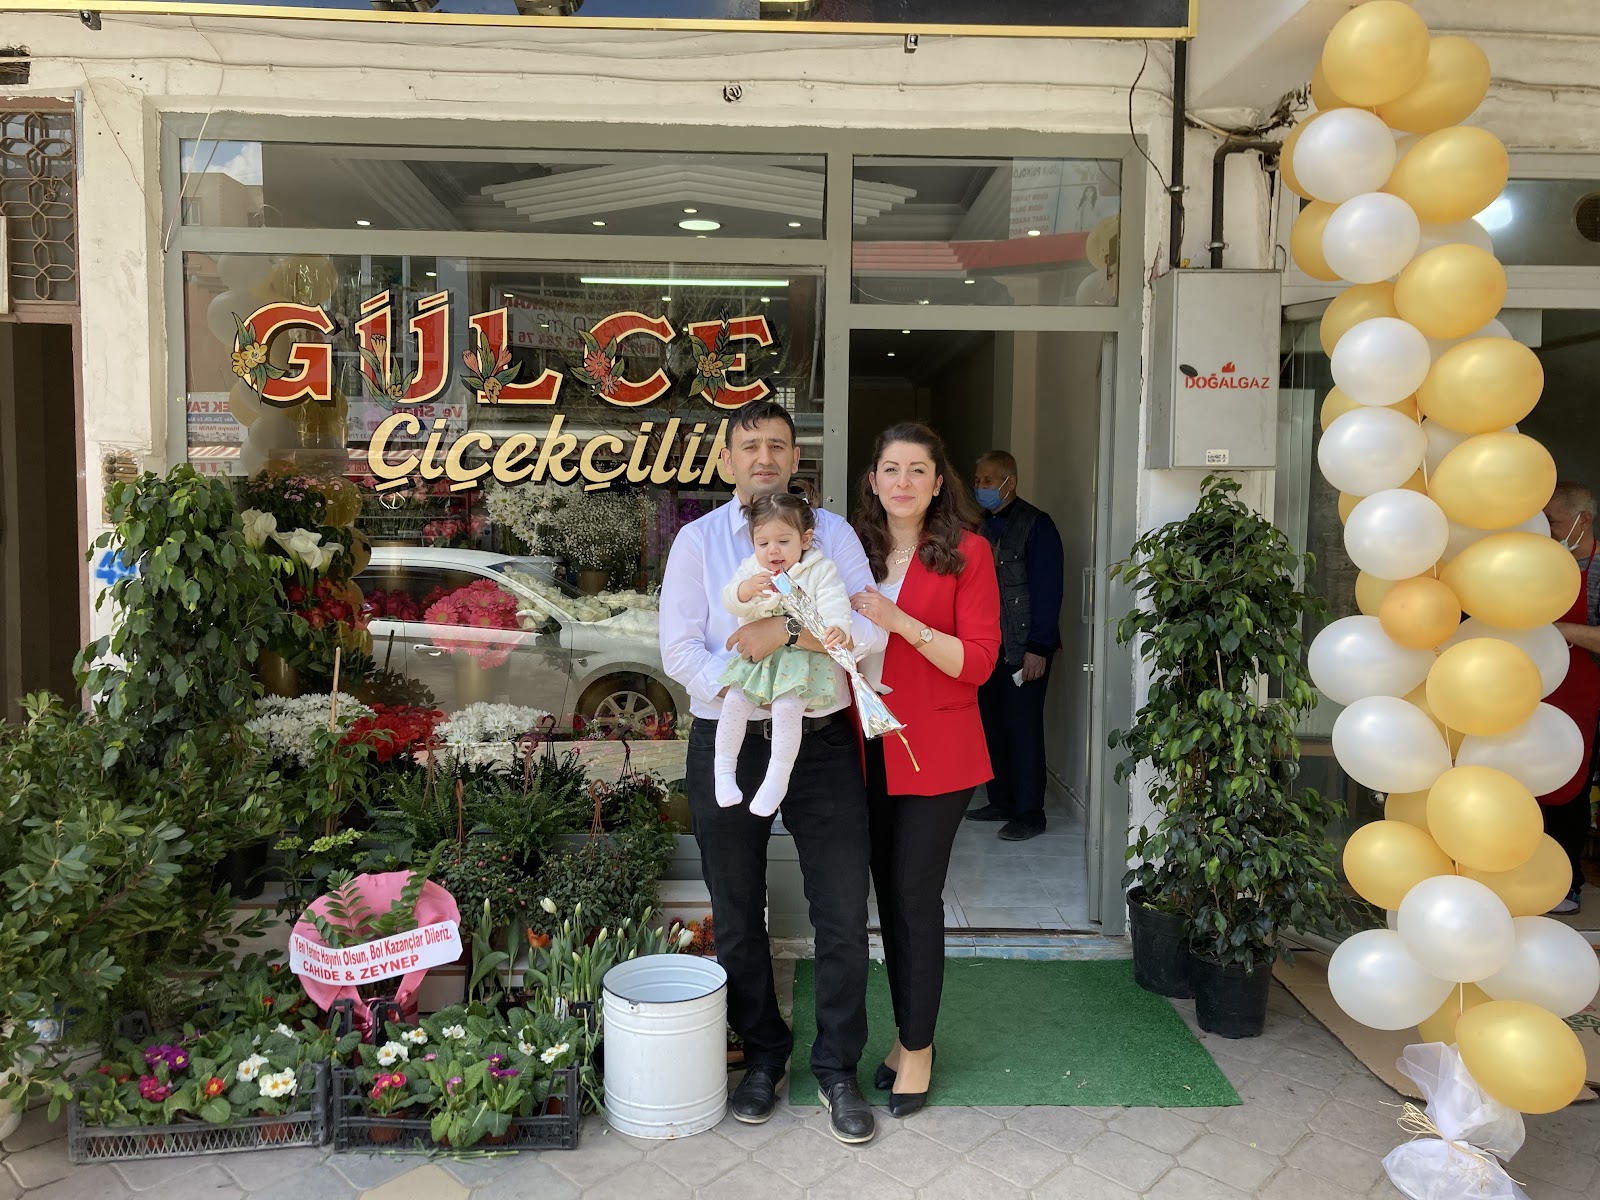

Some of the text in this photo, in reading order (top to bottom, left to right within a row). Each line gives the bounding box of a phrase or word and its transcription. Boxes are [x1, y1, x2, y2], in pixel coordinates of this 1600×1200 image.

[232, 288, 774, 410] GÜLCE
[1185, 373, 1270, 389] DOĞALGAZ
[294, 936, 306, 954] Yeni
[320, 949, 342, 969] Hayırlı
[342, 950, 369, 966] Olsun,
[369, 942, 384, 960] Bol
[384, 933, 423, 954] Kazançlar
[424, 925, 453, 945] Dileriz.
[303, 954, 419, 981] CAHİDE & ZEYNEP
